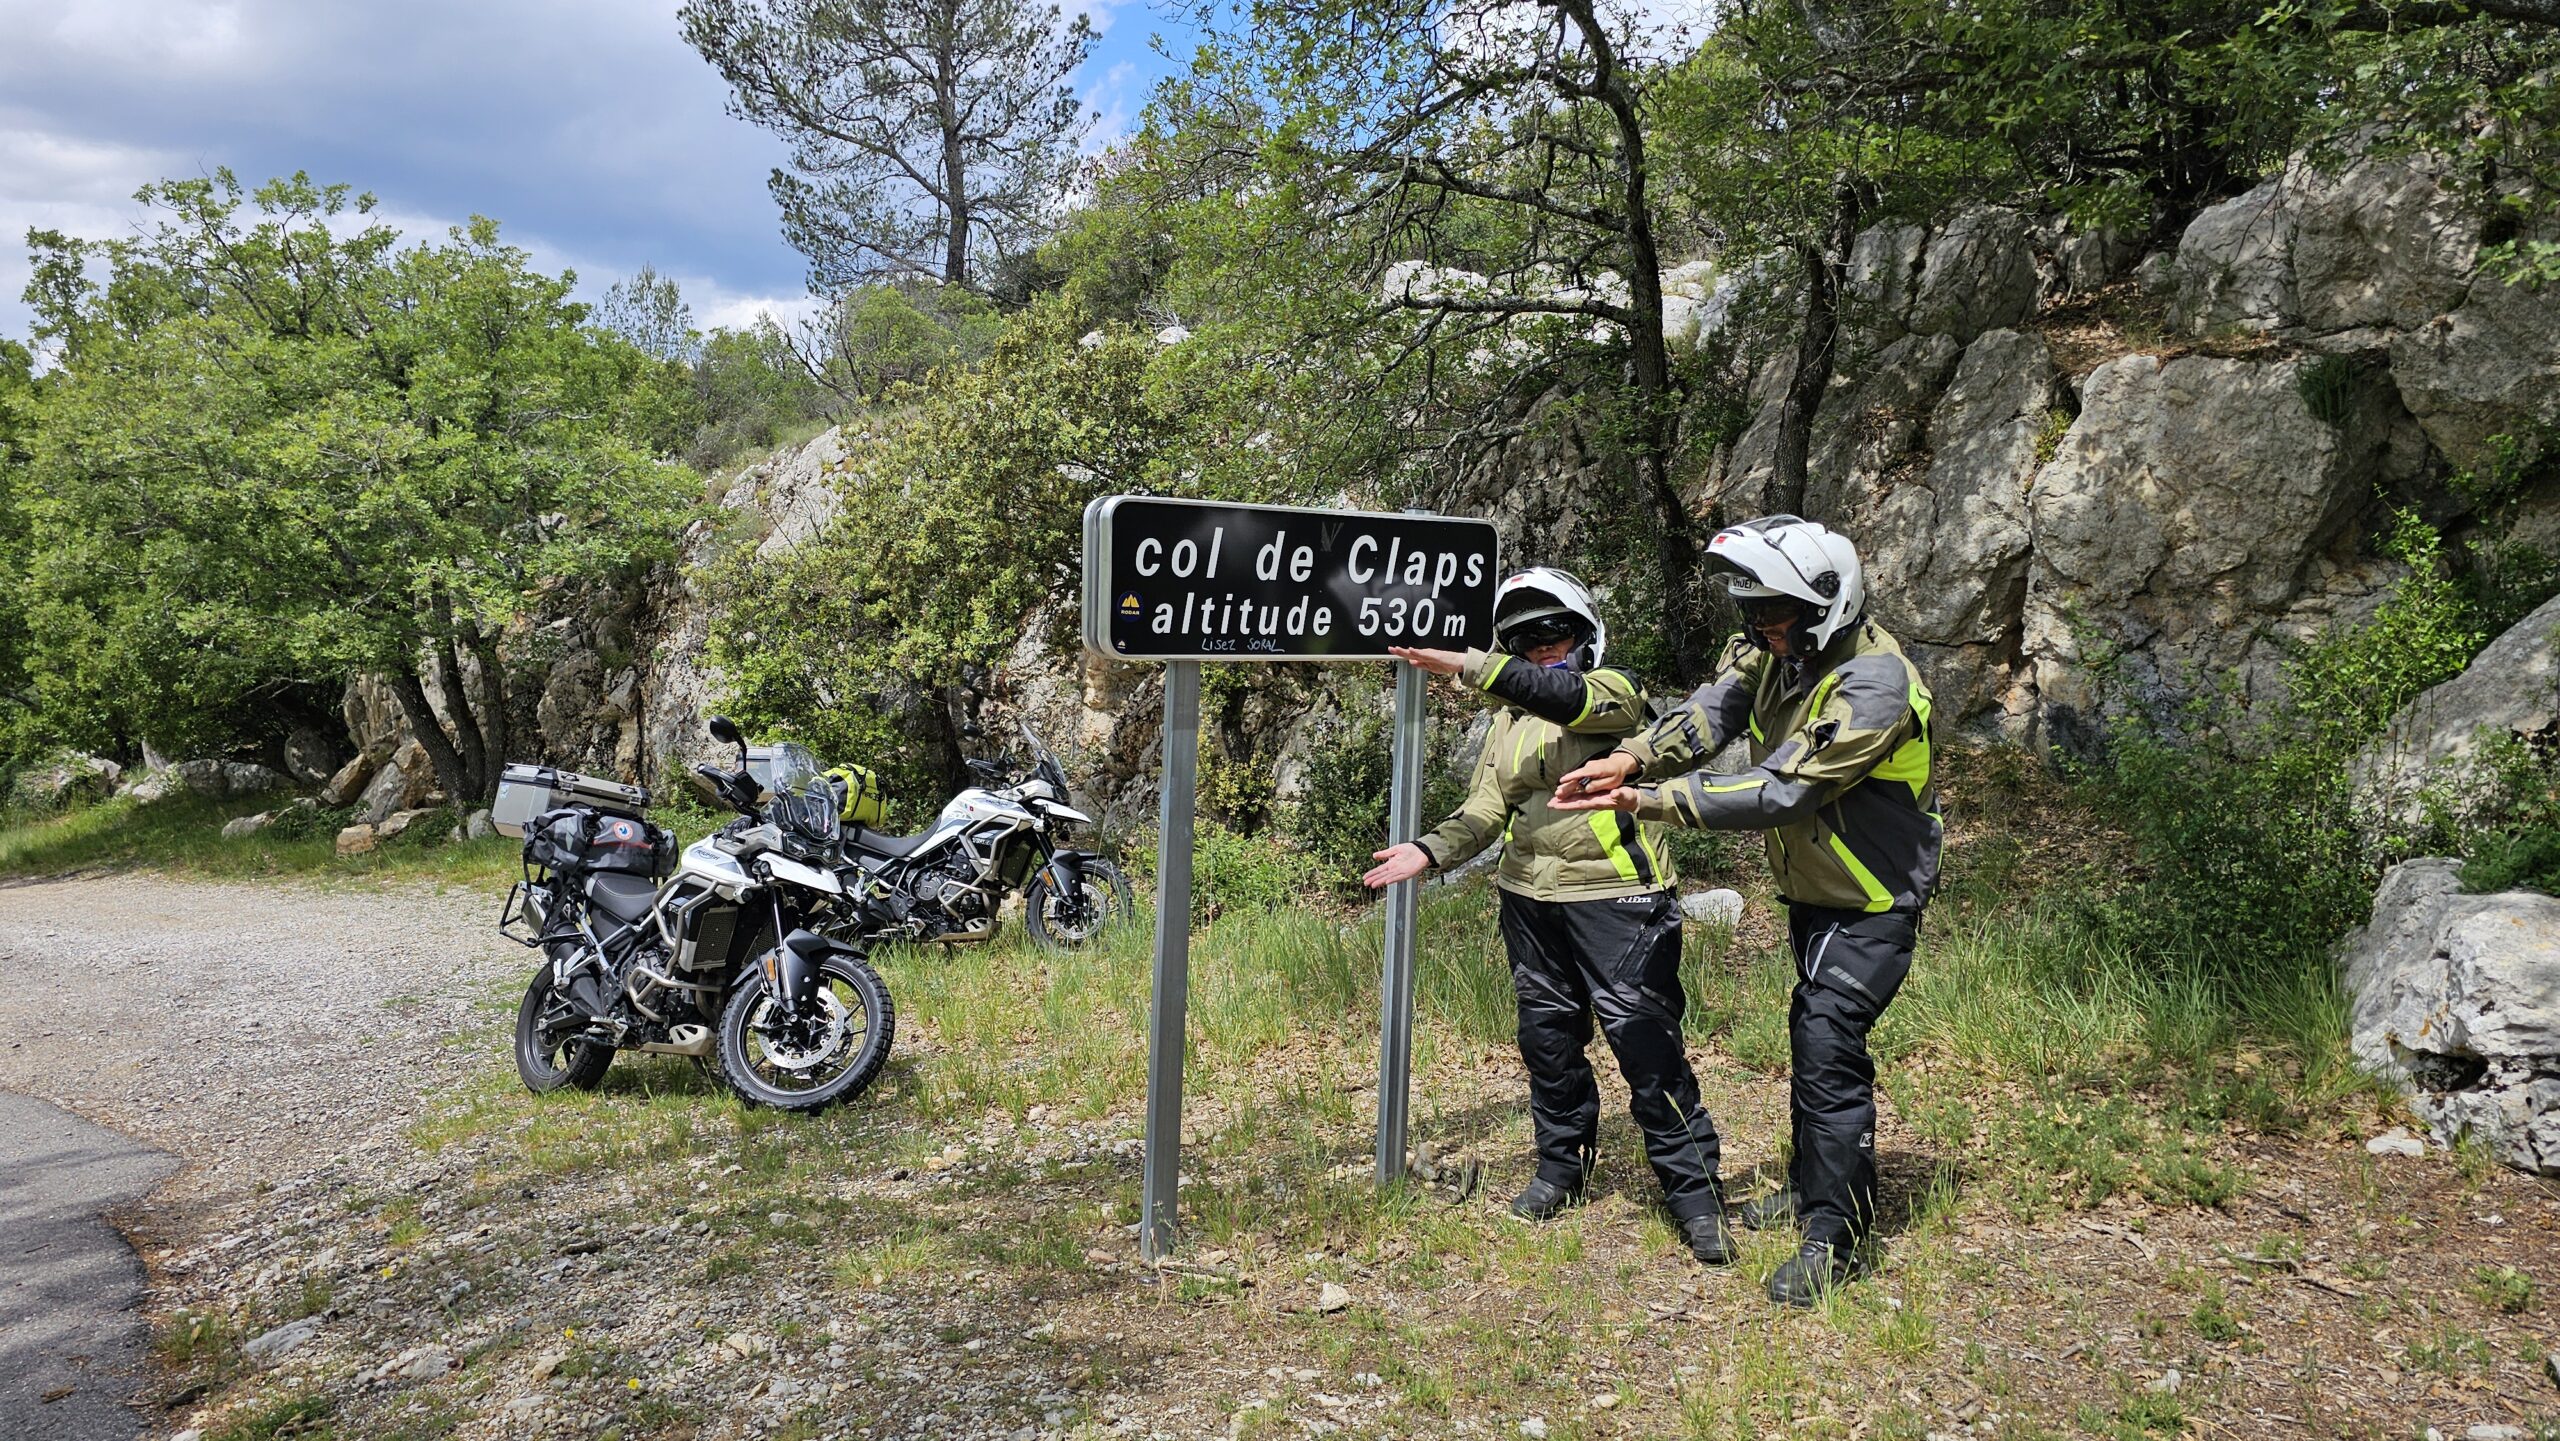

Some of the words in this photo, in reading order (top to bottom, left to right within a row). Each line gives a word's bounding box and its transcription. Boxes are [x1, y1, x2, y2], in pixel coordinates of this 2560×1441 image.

[1135, 527, 1224, 579] col
[1255, 530, 1314, 583] de
[1348, 534, 1485, 599] Claps
[1151, 592, 1332, 636] altitude
[1358, 597, 1435, 637] 530
[1442, 614, 1466, 637] m
